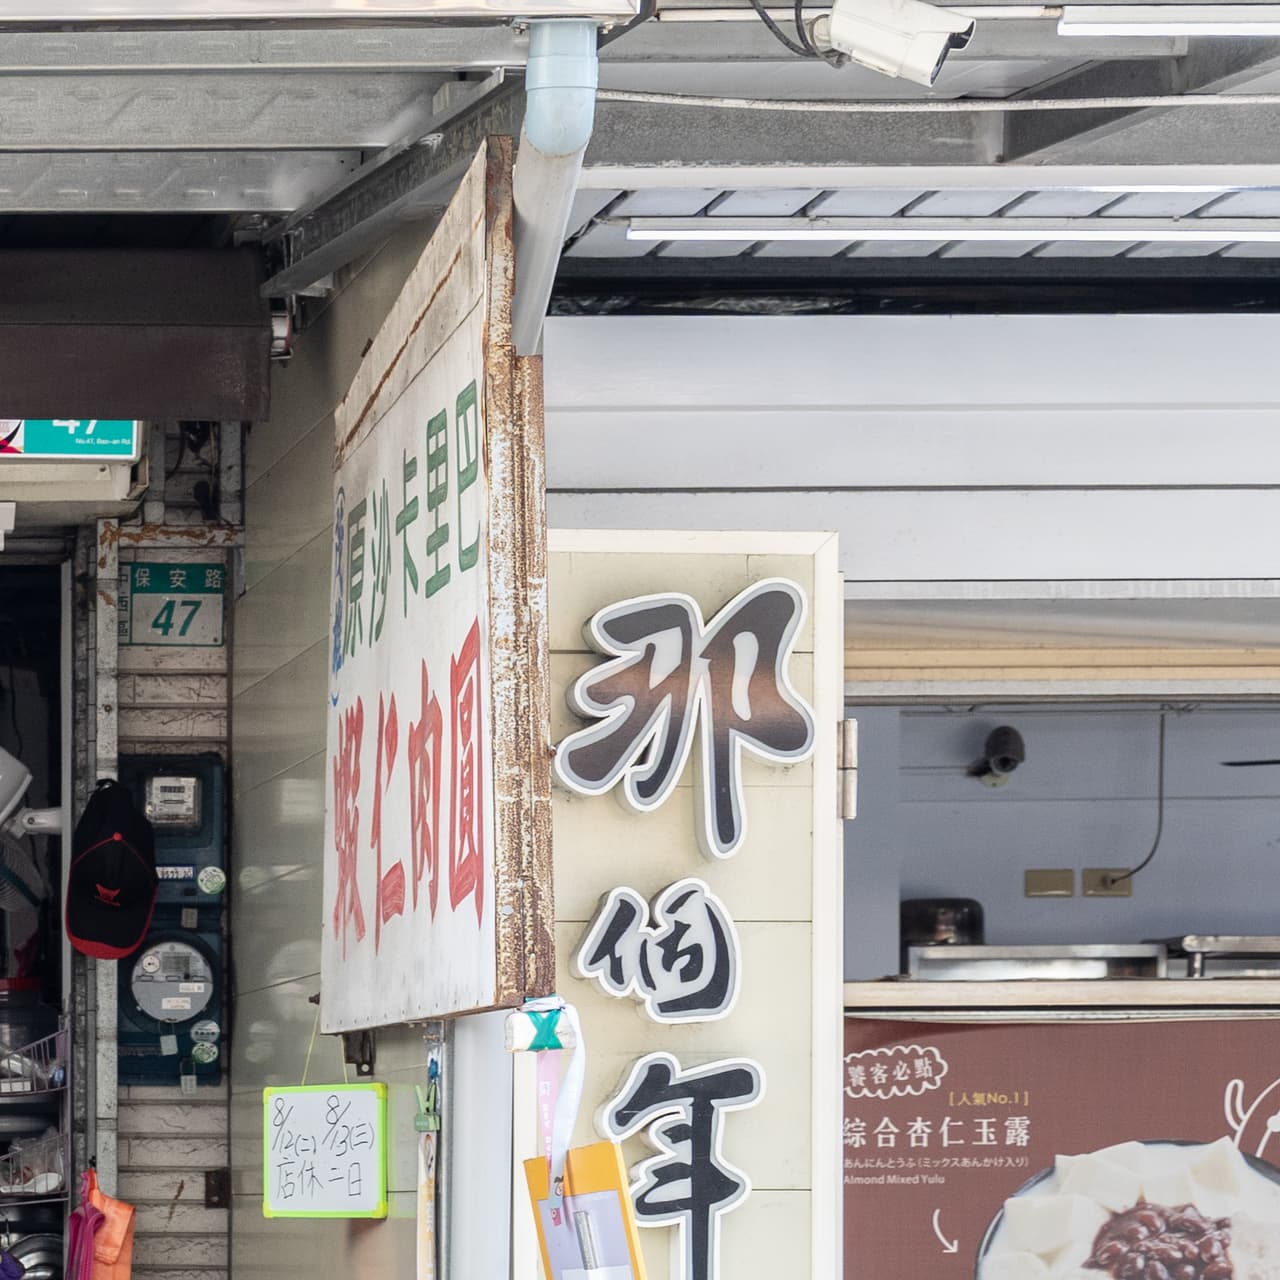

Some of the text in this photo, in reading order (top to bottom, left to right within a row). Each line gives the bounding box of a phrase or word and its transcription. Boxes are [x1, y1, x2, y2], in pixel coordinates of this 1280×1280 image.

[343, 378, 480, 657] 原沙卡里巴
[135, 568, 222, 589] 保安路
[151, 600, 203, 637] 47
[334, 615, 483, 961] 蝦仁肉圓
[843, 1116, 1031, 1148] 綜合杏仁玉露
[844, 1175, 945, 1185] Almond Mixed Yulu
